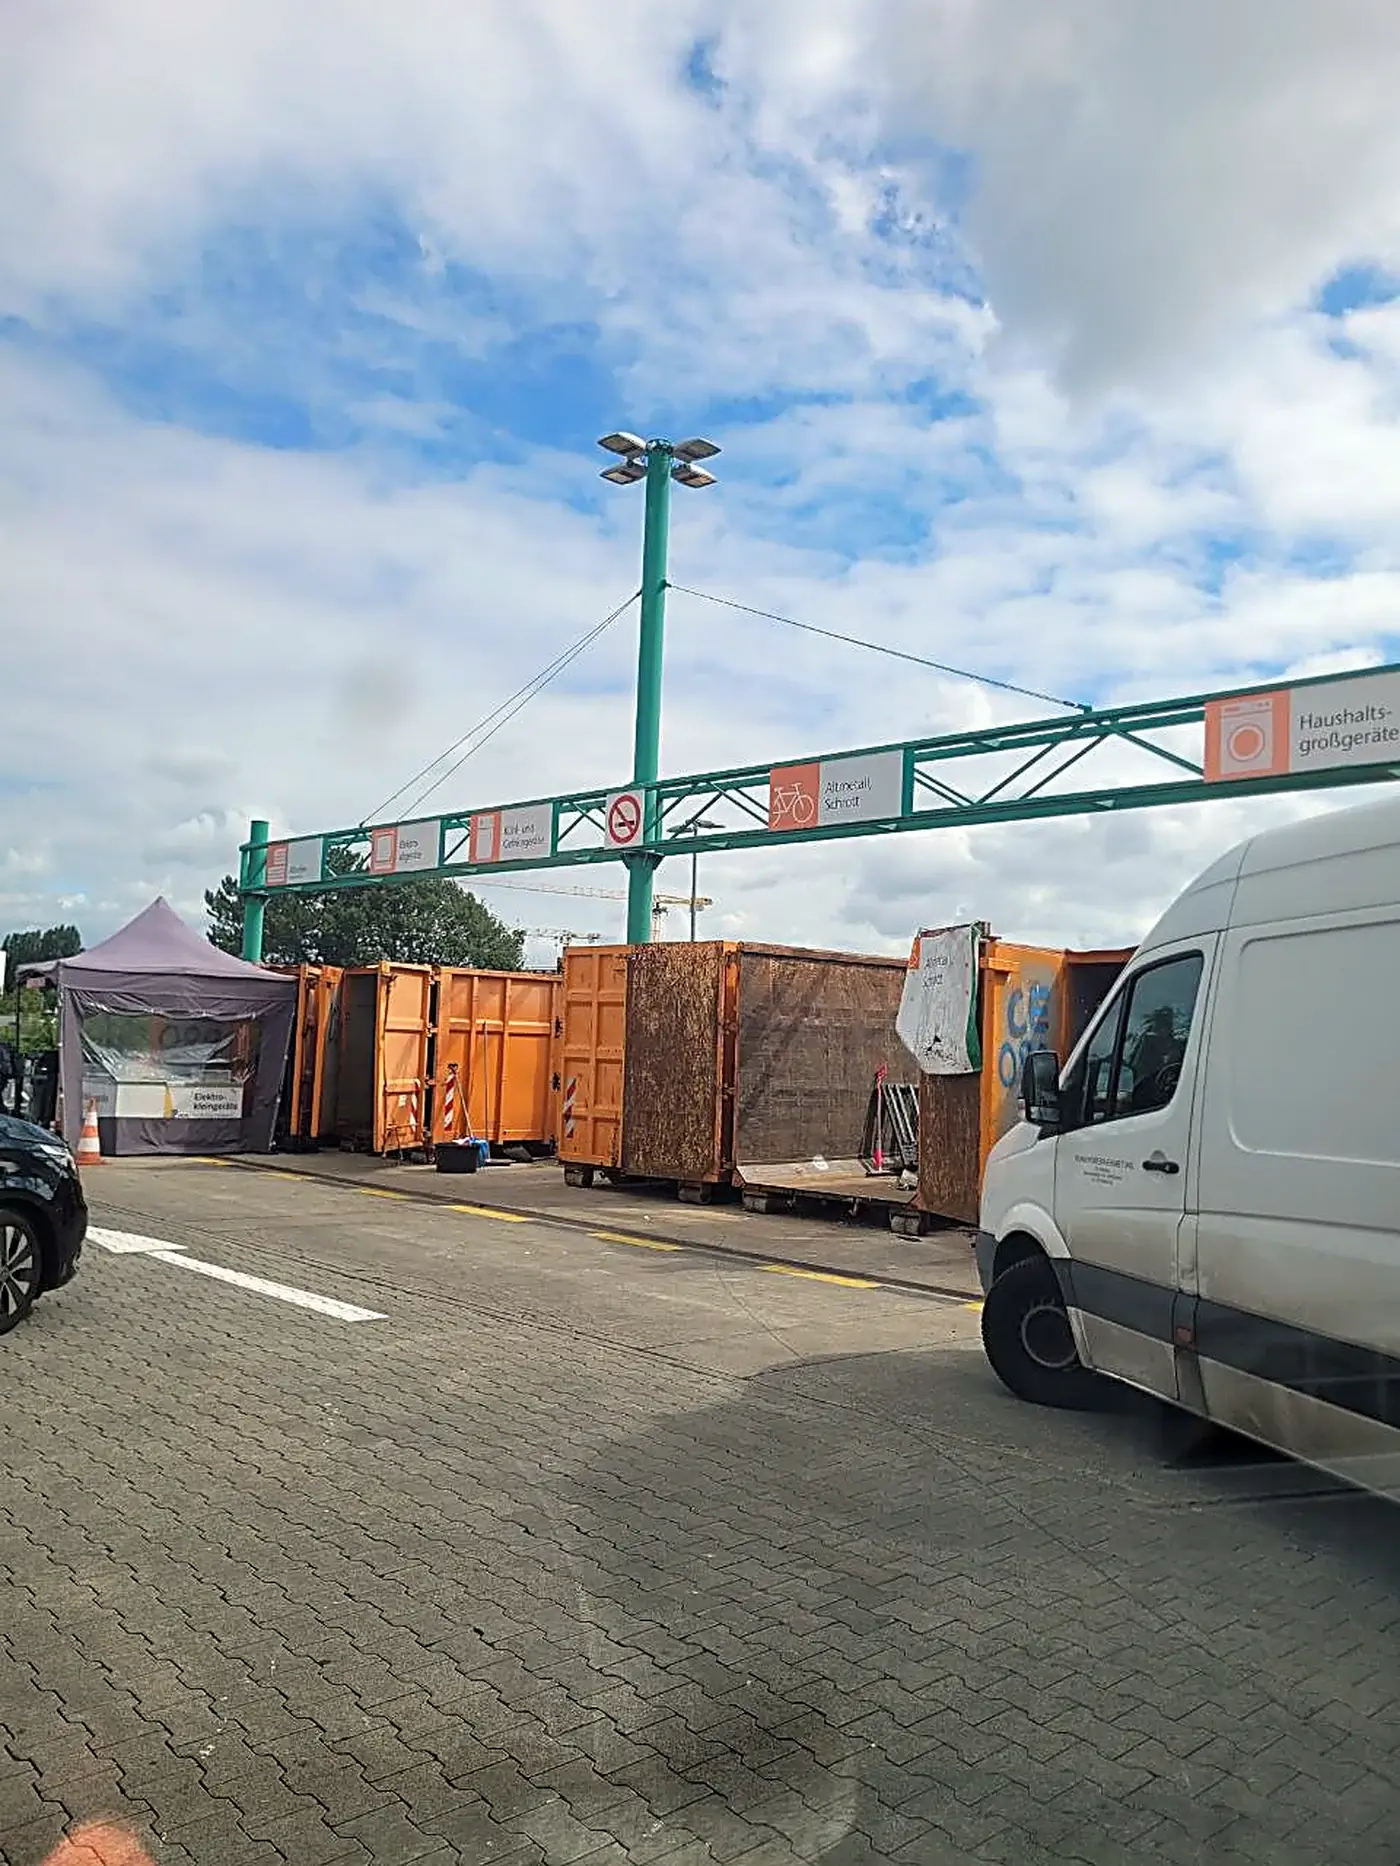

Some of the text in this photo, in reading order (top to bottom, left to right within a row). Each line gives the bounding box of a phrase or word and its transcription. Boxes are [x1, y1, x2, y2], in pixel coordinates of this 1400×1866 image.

[1300, 703, 1392, 730] Haushalts-
[1300, 728, 1399, 757] großgeräte
[825, 796, 860, 810] Schrott
